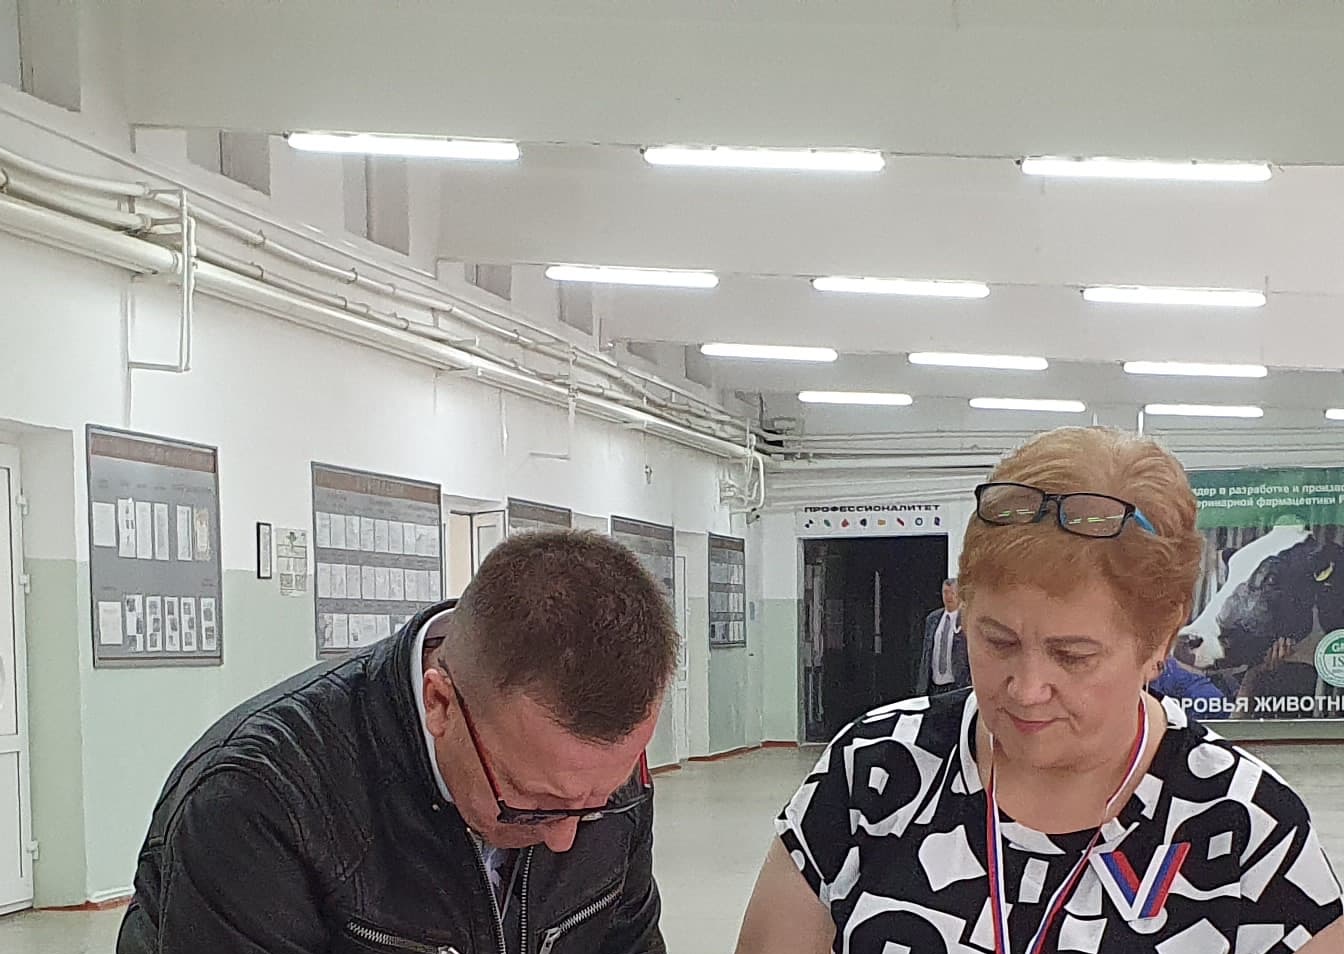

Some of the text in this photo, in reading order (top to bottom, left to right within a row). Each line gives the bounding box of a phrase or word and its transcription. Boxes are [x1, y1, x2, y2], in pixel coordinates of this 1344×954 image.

[1229, 484, 1290, 496] разработке
[1256, 495, 1336, 509] фармацевтики
[804, 504, 941, 513] ПРОФЕССИОНАЛИТЕТ
